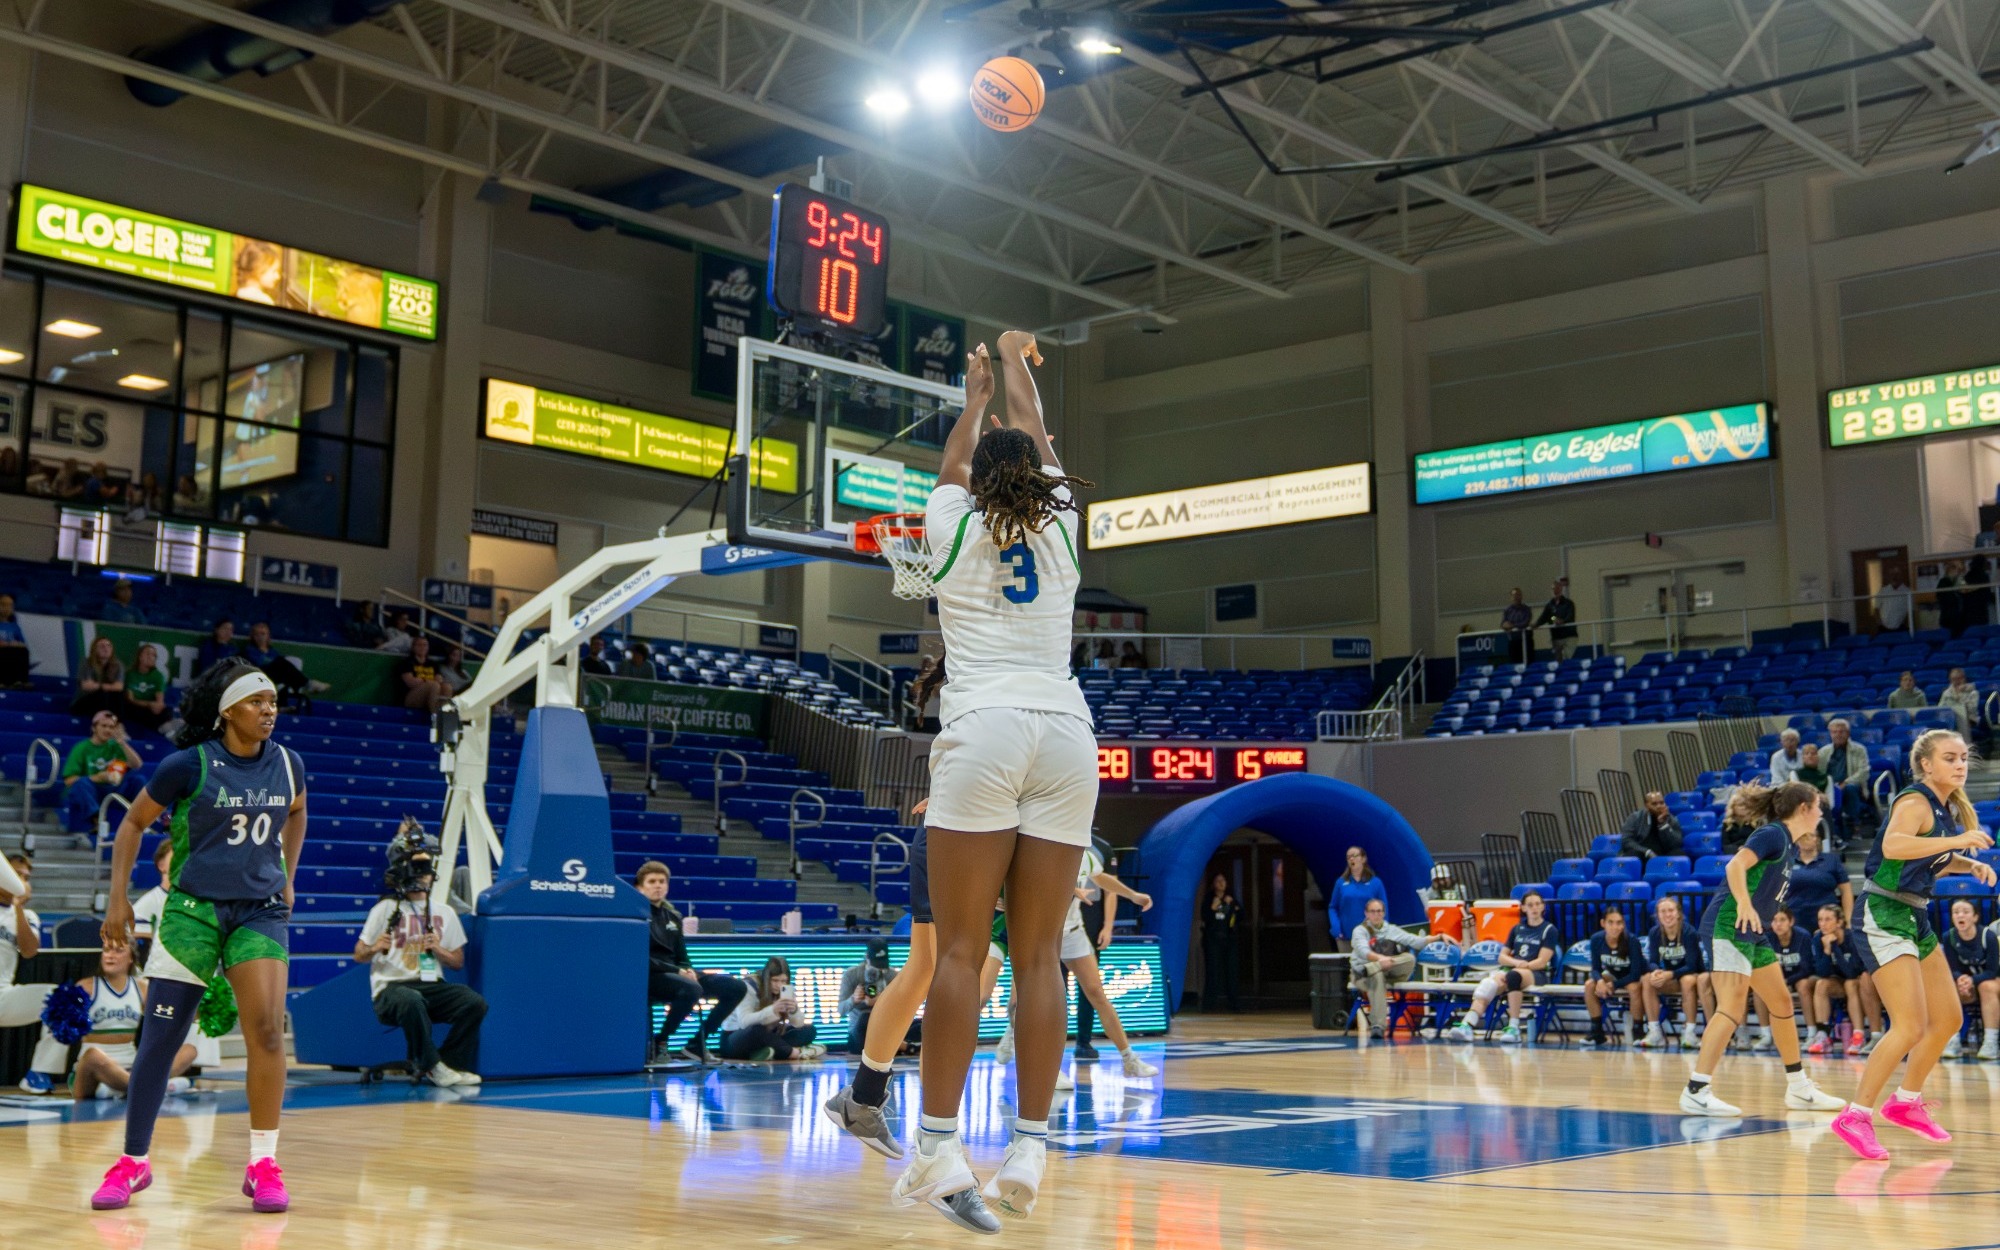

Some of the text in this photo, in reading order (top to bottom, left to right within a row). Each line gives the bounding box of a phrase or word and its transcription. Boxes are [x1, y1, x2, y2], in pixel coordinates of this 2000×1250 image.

[36, 203, 179, 262] CLOSER
[807, 201, 882, 265] 9:24
[182, 242, 206, 257] YOU
[389, 282, 433, 301] NAPLES
[818, 258, 858, 323] 10
[387, 293, 433, 317] ZOO
[1831, 389, 1872, 408] GET
[1878, 379, 1937, 401] YOUR
[591, 407, 632, 428] Company
[1842, 391, 2000, 441] 239.59
[1532, 426, 1645, 464] Go Eagles!
[1418, 459, 1427, 468] To
[1428, 457, 1442, 466] the
[1440, 467, 1458, 479] your
[1192, 477, 1364, 510] COMMERCIAL AIR MANAGEMENT
[1278, 491, 1362, 510] Representative
[1115, 502, 1191, 531] CAM
[283, 561, 313, 586] LL
[999, 542, 1040, 604] 3
[682, 708, 732, 730] COFFEE
[1097, 748, 1129, 779] 28
[1152, 748, 1213, 779] 9:24
[1236, 749, 1262, 780] 15
[227, 812, 272, 846] 30
[577, 882, 616, 895] Sports
[1519, 943, 1530, 957] 8
